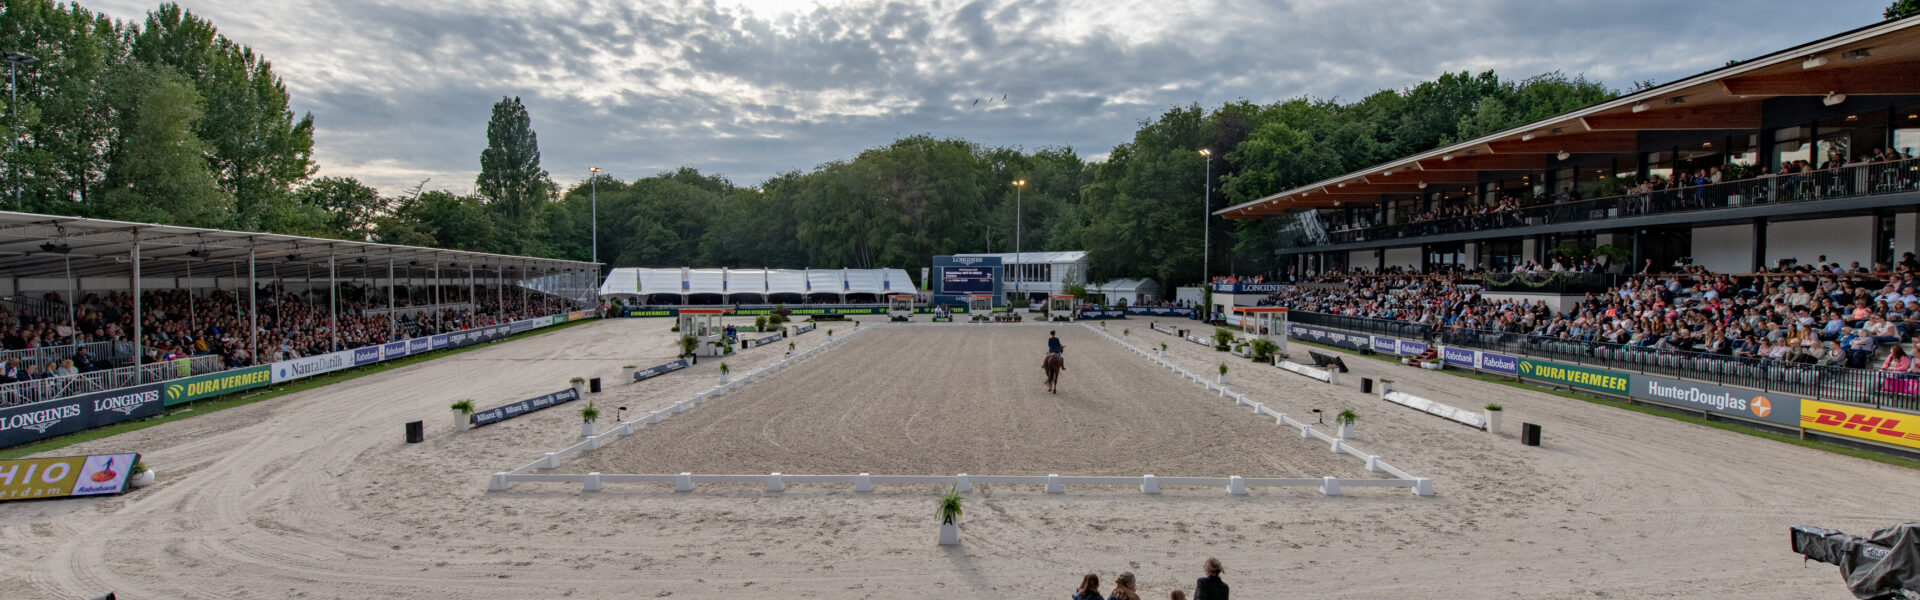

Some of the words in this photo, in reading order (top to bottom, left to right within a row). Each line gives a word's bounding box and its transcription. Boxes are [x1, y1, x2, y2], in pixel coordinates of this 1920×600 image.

[411, 340, 428, 351] Rabobank
[1348, 335, 1368, 345] LONGINES
[1376, 339, 1395, 350] Rabobank
[386, 344, 405, 356] Rabobank
[1401, 344, 1424, 355] Rabobank
[356, 350, 378, 361] Rabobank
[1446, 350, 1473, 363] Rabobank
[292, 354, 343, 377] NautaDutilh
[1484, 354, 1516, 371] Rabobank
[187, 379, 220, 397] DURA
[221, 370, 270, 391] VERMEER
[1536, 365, 1566, 381] DURA
[1566, 370, 1627, 391] VERMEER
[94, 390, 160, 412] LONGINES
[505, 405, 522, 414] Allianz
[0, 404, 81, 431] LONGINES
[477, 412, 496, 422] Allianz
[1815, 408, 1906, 438] DHL
[78, 485, 117, 493] Rabobank
[943, 514, 953, 525] A
